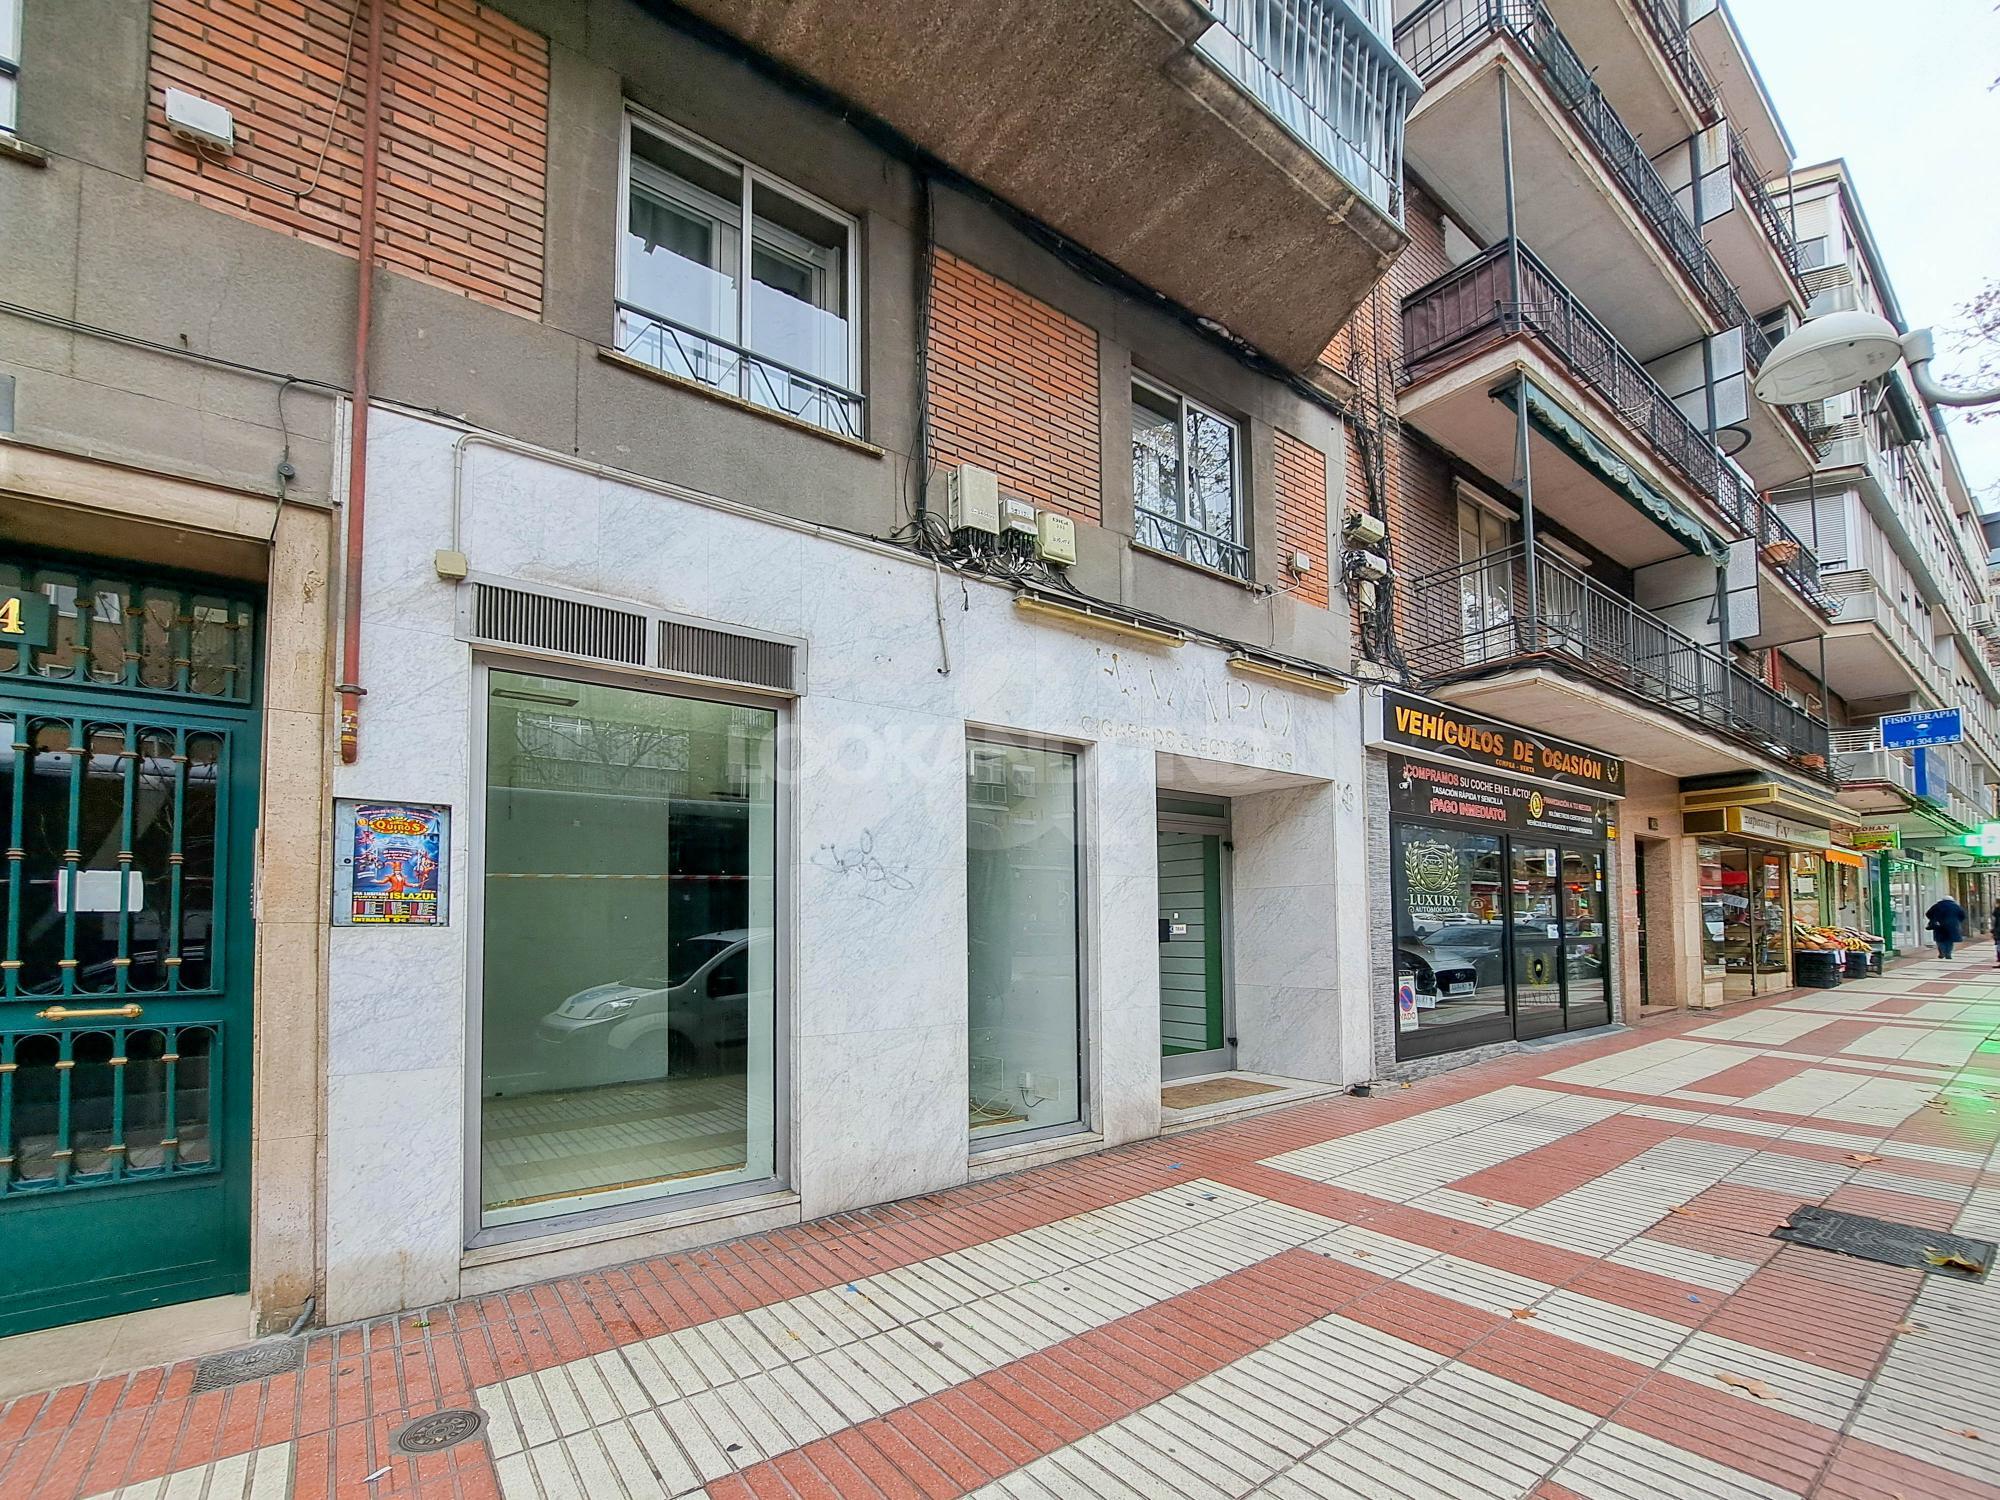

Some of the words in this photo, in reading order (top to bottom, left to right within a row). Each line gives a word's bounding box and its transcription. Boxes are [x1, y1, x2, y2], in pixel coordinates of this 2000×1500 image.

[1884, 709, 1958, 725] FISIOTERAPIA
[1395, 705, 1505, 756] VEHÍCULOS
[1513, 740, 1534, 764] DE
[1542, 747, 1601, 780] OCASIÓN
[1917, 737, 1932, 745] 304
[1936, 735, 1946, 743] 35
[1460, 776, 1470, 787] SU
[1470, 779, 1494, 793] COCHE
[1494, 784, 1504, 794] EN
[1504, 787, 1512, 796] EL
[1512, 788, 1531, 799] ACTO!
[1430, 797, 1458, 814] ¡PAGO
[389, 892, 437, 900] ISLAZUL
[1410, 894, 1458, 907] LUXURY
